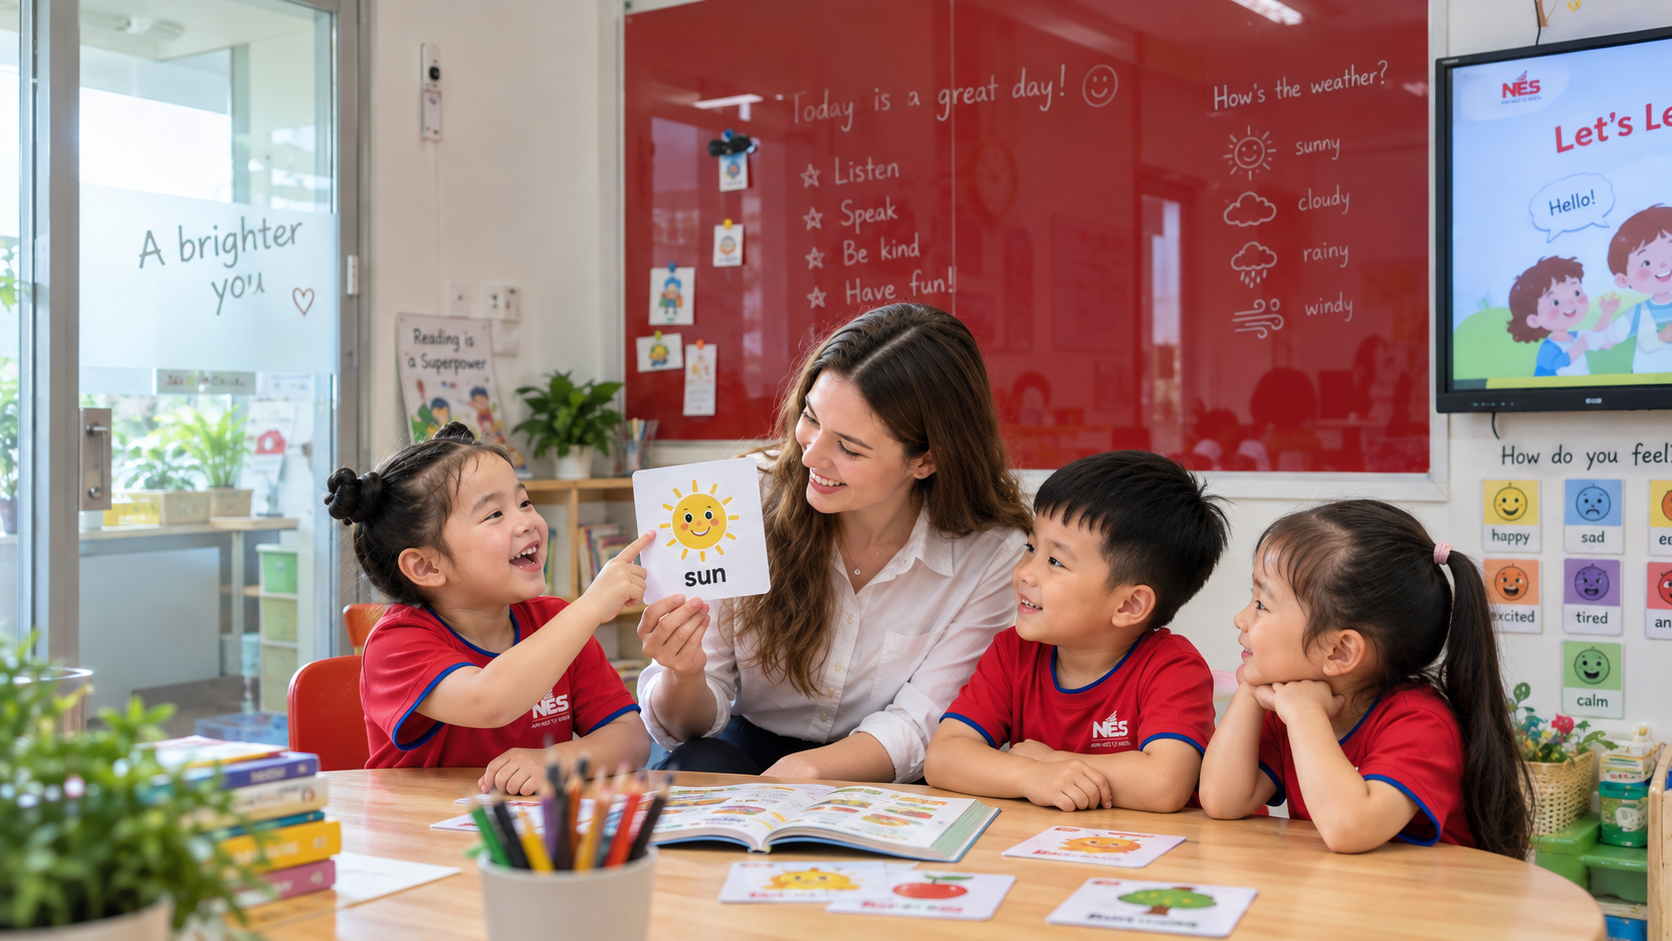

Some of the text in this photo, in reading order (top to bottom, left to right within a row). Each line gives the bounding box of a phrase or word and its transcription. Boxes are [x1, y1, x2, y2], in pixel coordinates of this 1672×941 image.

[788, 64, 1065, 132] Today is a great day!
[1214, 60, 1388, 110] How's the weather?
[1502, 80, 1541, 98] NES
[1295, 138, 1341, 161] sunny
[835, 157, 900, 186] Listen
[1298, 185, 1350, 214] cloudy
[1549, 190, 1596, 216] Hello!
[840, 197, 899, 234] Speak
[139, 216, 303, 269] A brighter
[843, 232, 920, 265] Be kind
[1303, 242, 1349, 268] rainy
[211, 272, 265, 316] you
[846, 266, 955, 305] Have fun!
[1305, 292, 1353, 322] windy
[413, 328, 475, 353] Reading is
[408, 353, 487, 375] a Superpower
[1501, 442, 1672, 471] How do you feel
[1491, 529, 1530, 545] happy
[1581, 531, 1605, 544] sad
[684, 566, 727, 588] sun
[1576, 611, 1608, 625] tired
[532, 694, 569, 719] NES
[1576, 694, 1609, 708] calm
[1092, 720, 1128, 738] NES
